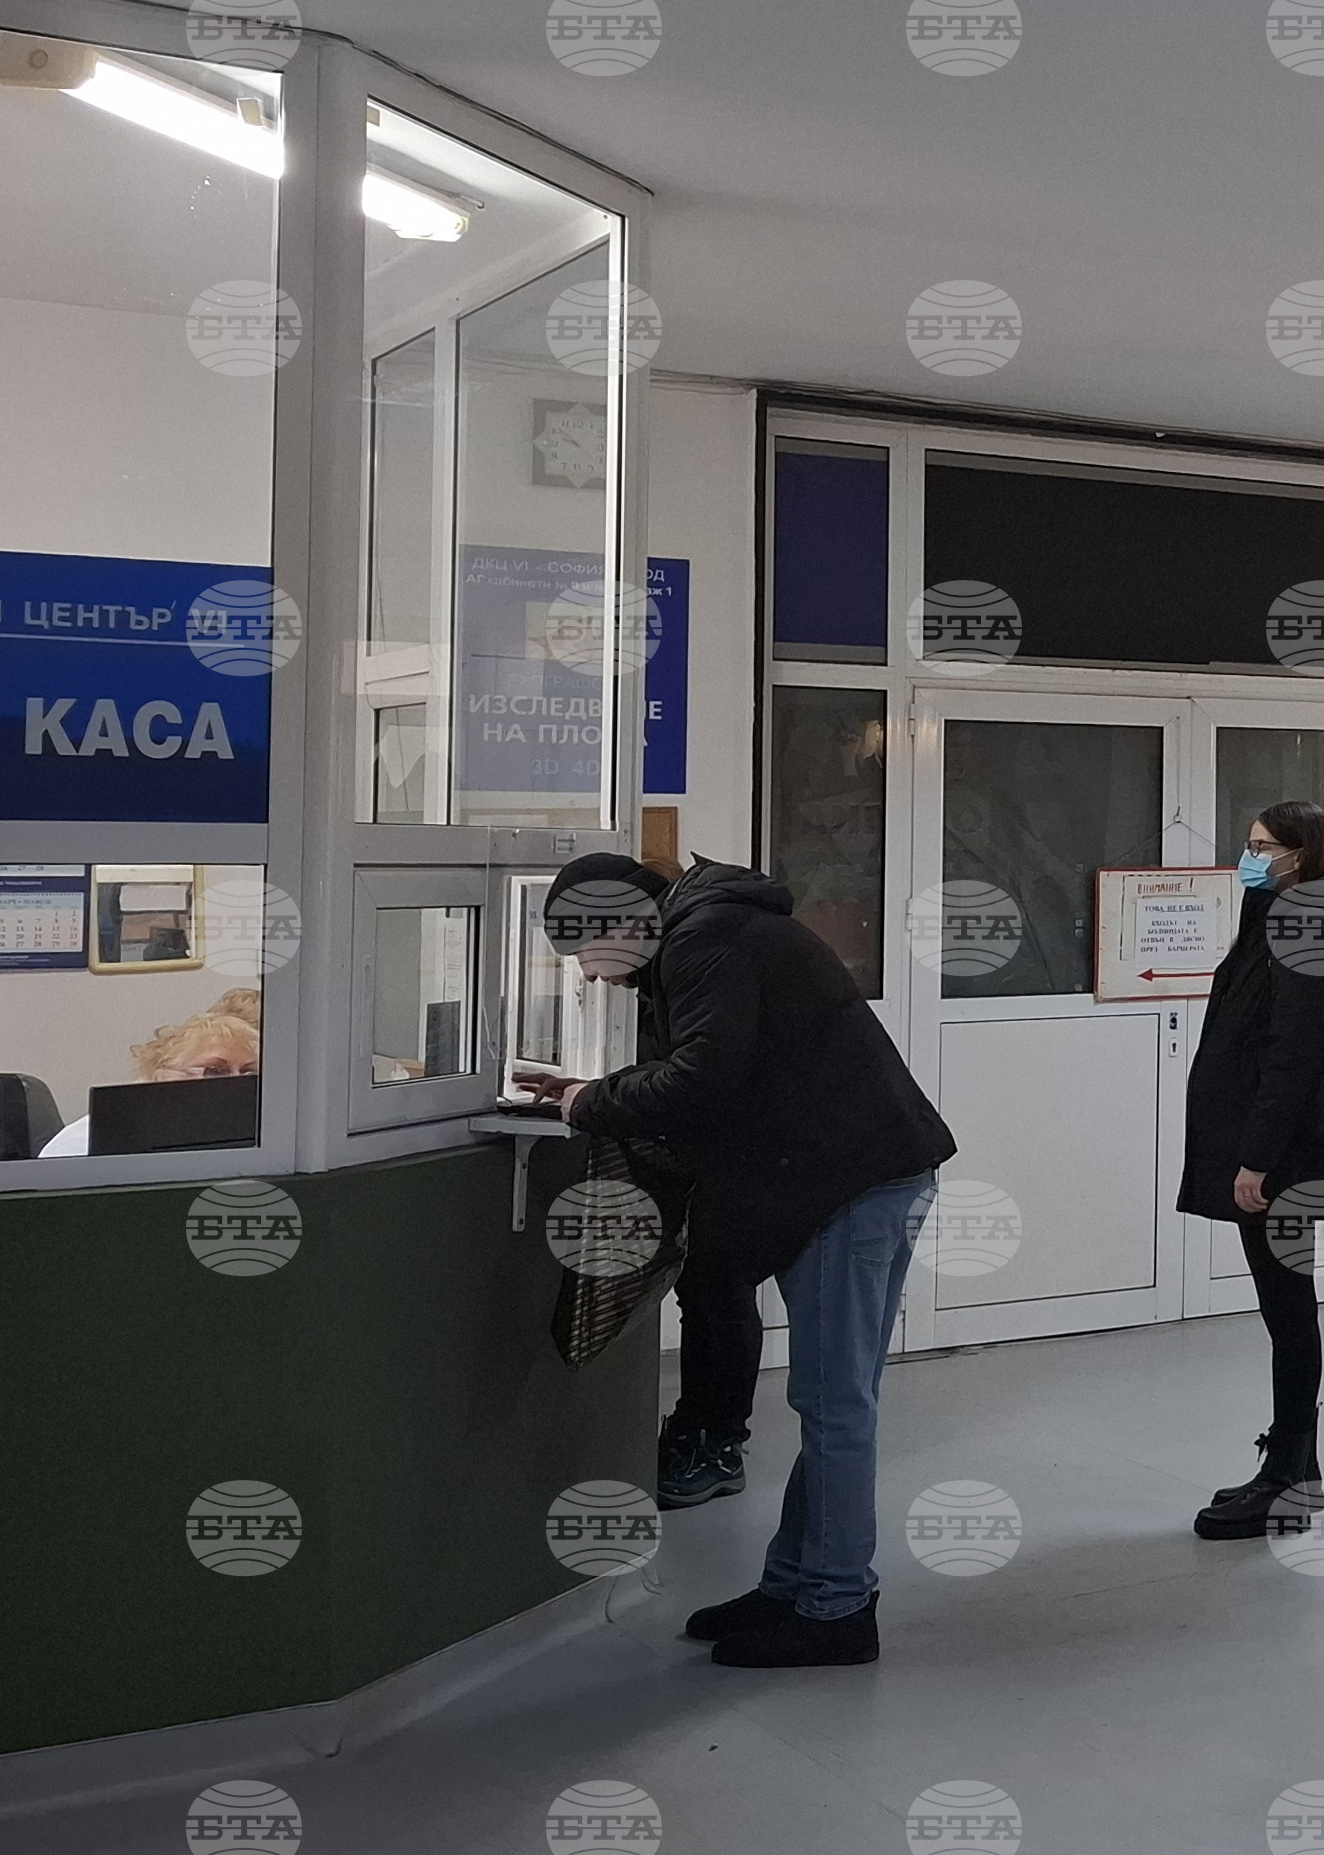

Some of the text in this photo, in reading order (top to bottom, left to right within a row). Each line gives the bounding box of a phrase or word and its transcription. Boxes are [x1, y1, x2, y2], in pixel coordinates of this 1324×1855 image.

[24, 601, 229, 635] ЦЕНТЪР VI
[25, 697, 235, 760] КАСА
[483, 722, 527, 744] НА
